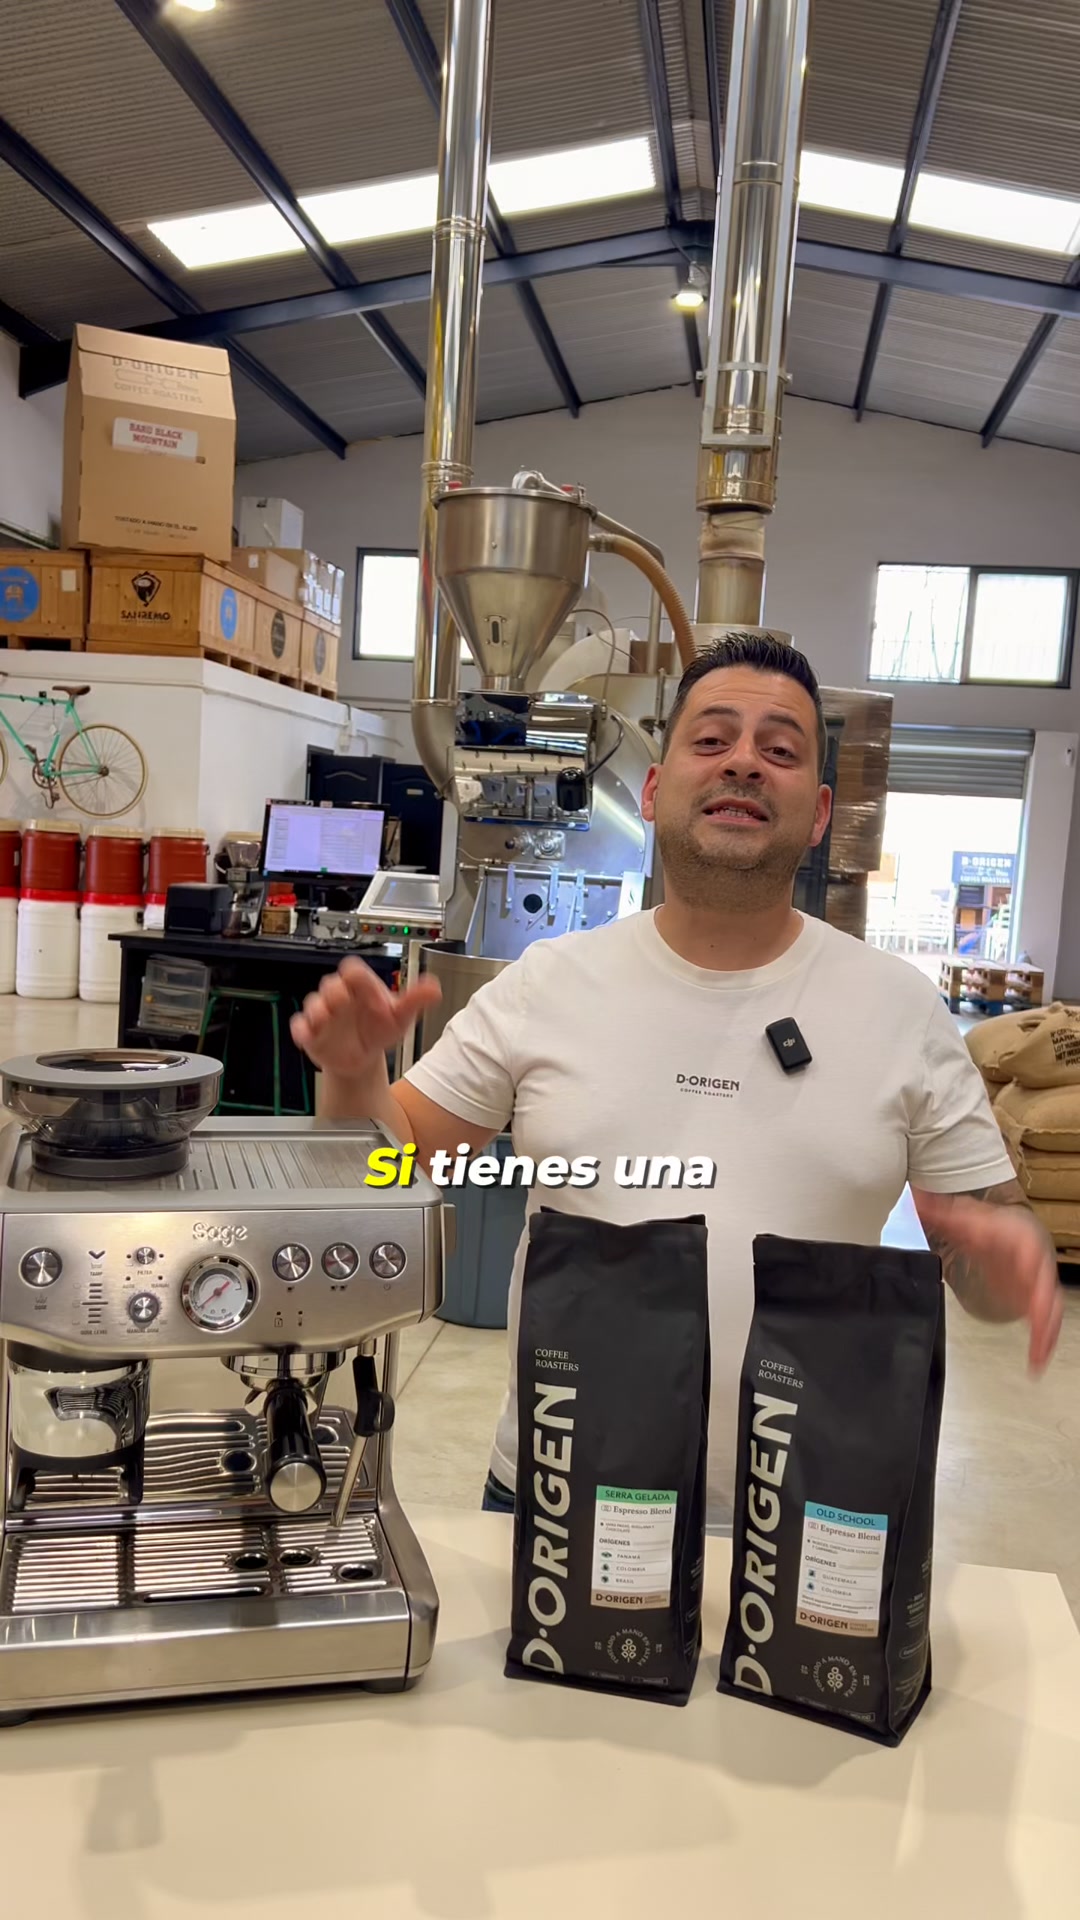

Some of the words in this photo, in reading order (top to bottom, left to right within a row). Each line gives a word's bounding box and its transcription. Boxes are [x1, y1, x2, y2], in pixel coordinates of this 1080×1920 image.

[155, 428, 183, 440] BLACK
[133, 434, 178, 449] MOUNTAIN
[121, 610, 171, 621] SANREMO
[680, 1087, 701, 1095] COFFEE
[192, 1222, 248, 1247] Sage
[535, 1348, 569, 1360] COFFEE
[535, 1359, 579, 1372] ROASTERS
[760, 1359, 795, 1375] COFFEE
[758, 1369, 804, 1389] ROASTERS
[605, 1489, 633, 1500] SERRA
[635, 1493, 671, 1501] GELADA
[613, 1505, 648, 1515] Espresso
[650, 1507, 672, 1515] Blend
[816, 1508, 836, 1519] OLD
[837, 1513, 876, 1526] SCHOOL
[820, 1524, 856, 1539] Espresso
[858, 1532, 881, 1541] Blend
[822, 1574, 857, 1584] GUATEMALA
[821, 1586, 852, 1597] COLOMBIA
[621, 1628, 643, 1638] MANO
[813, 1661, 825, 1692] TOSTADO
[827, 1655, 850, 1666] MANO
[843, 1678, 858, 1697] ALTEA
